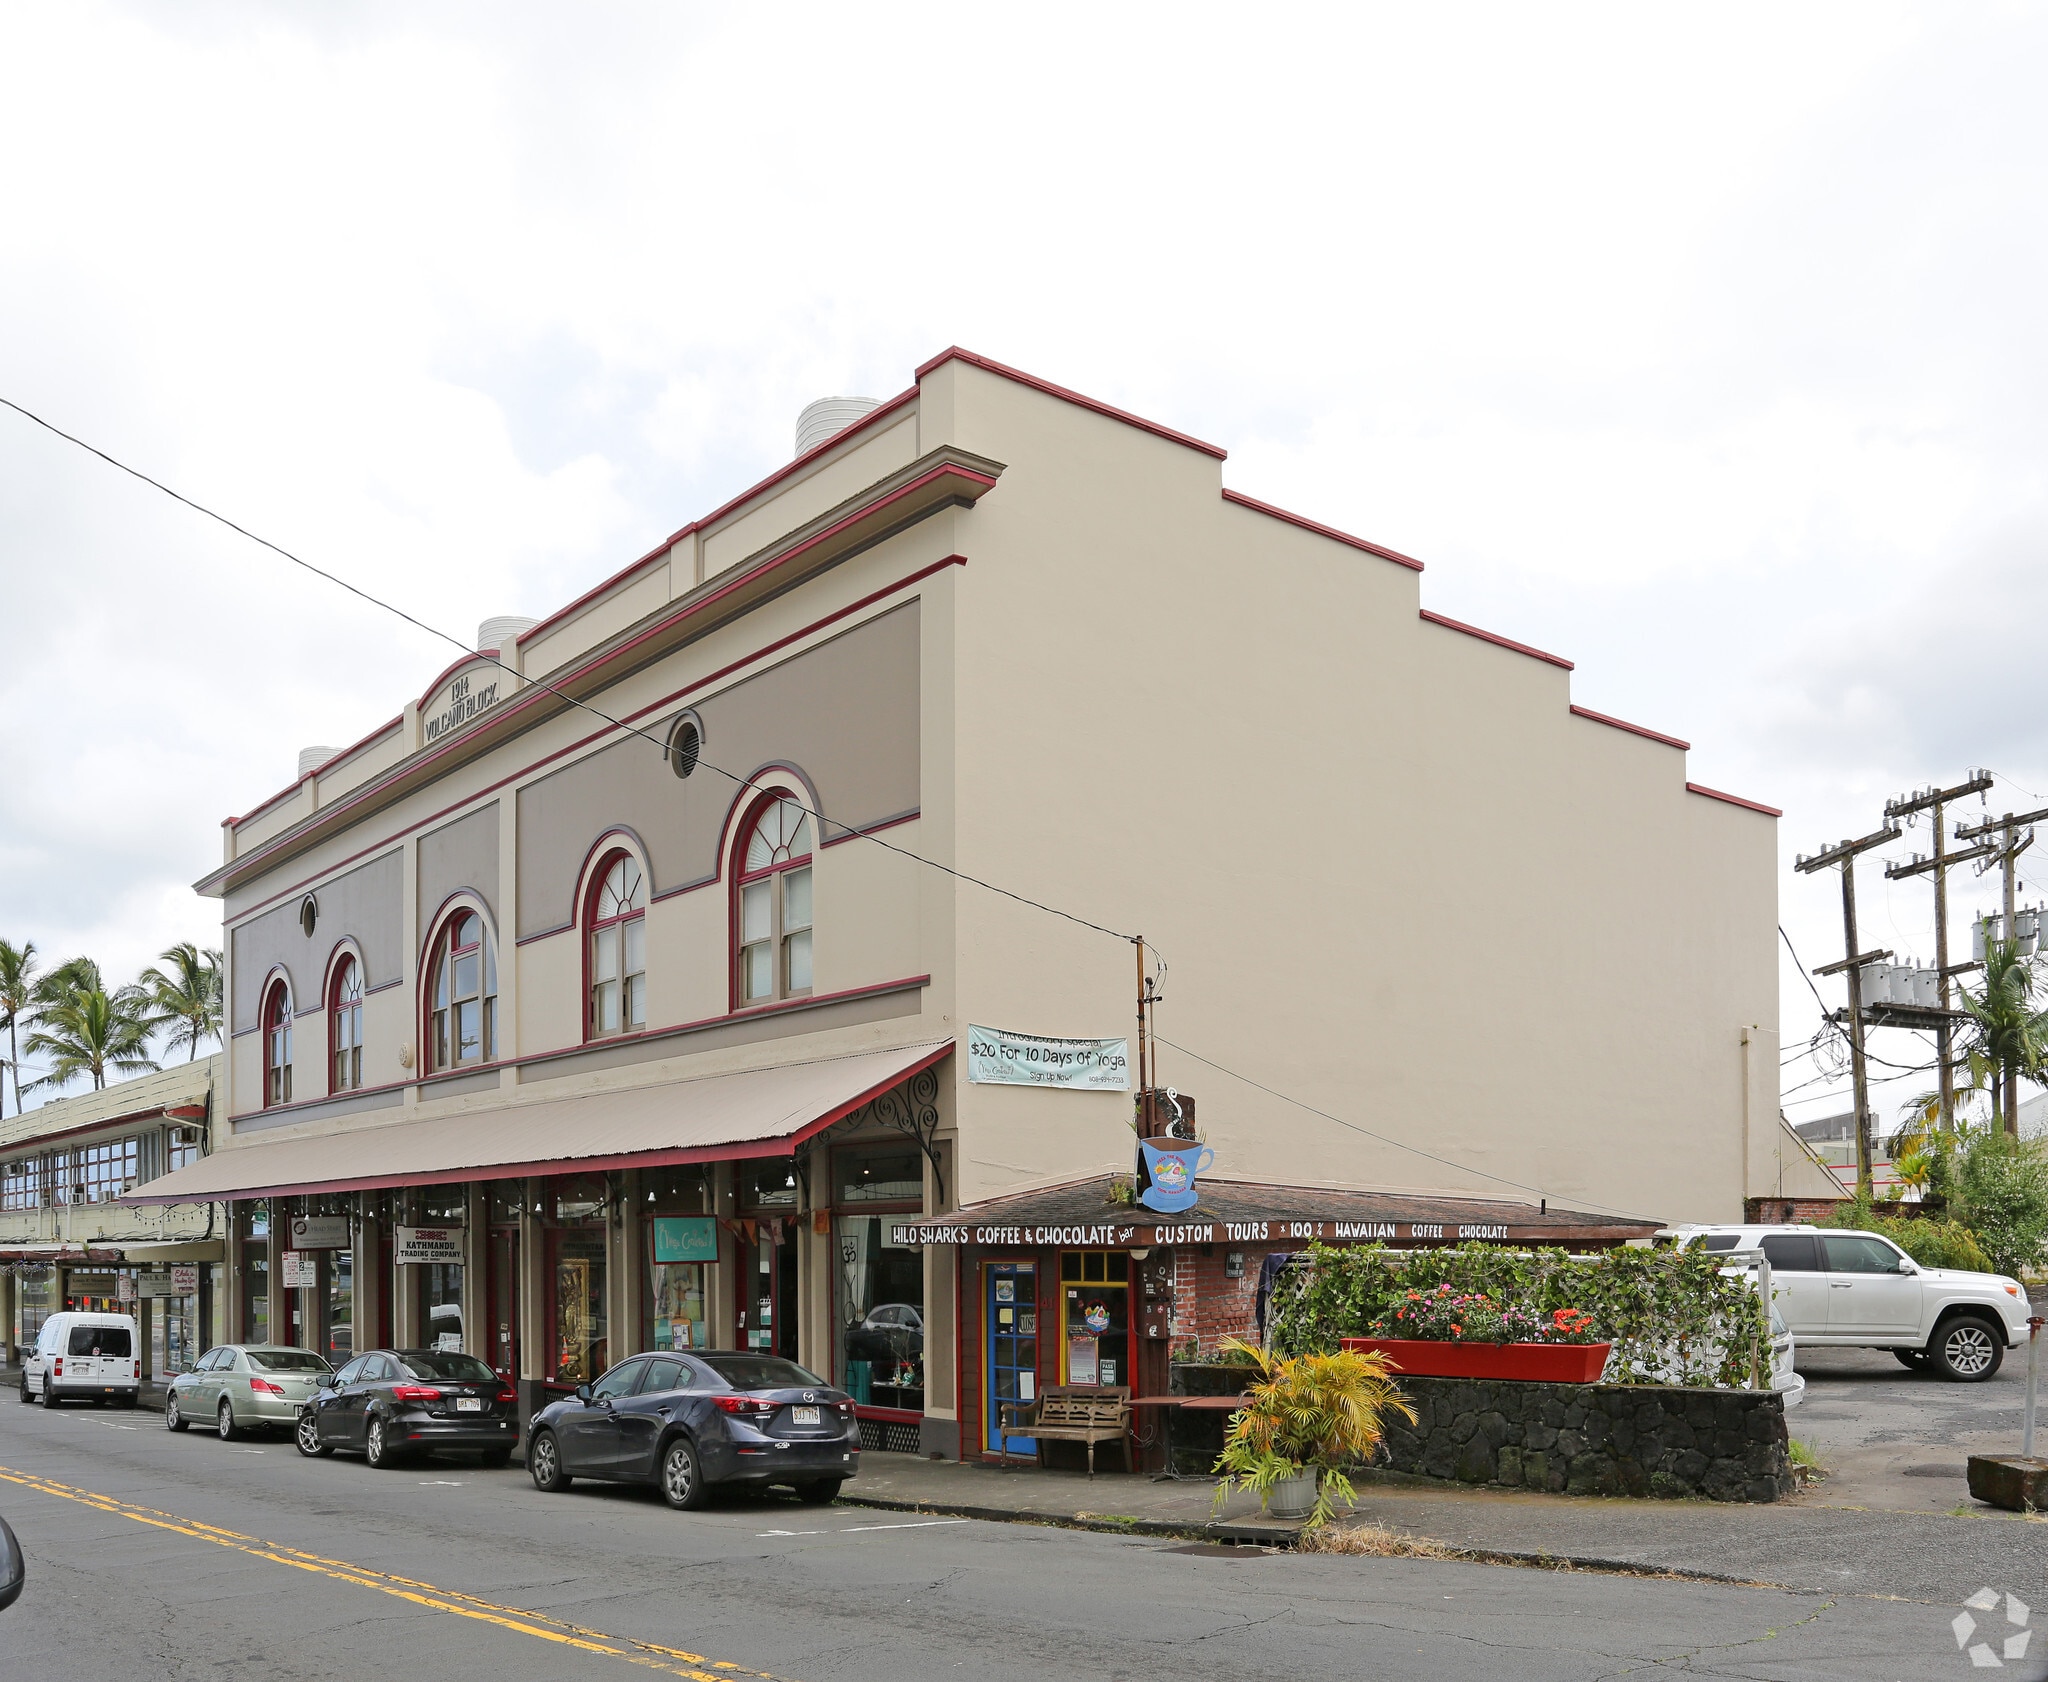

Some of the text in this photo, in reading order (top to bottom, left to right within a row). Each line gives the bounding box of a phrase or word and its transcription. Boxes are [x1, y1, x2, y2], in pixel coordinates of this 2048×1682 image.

[452, 677, 470, 702] 1914
[426, 703, 465, 741] VOLCANO
[970, 1042, 1126, 1071] $20 For 10 Days Of Yoga
[1029, 1071, 1045, 1082] Sign
[1046, 1073, 1055, 1083] Up
[892, 1225, 1135, 1245] HILO SHARK'S COFFEE & CHOCOLATE bar
[1155, 1224, 1213, 1243] CUSTOM
[1226, 1222, 1269, 1241] TOURS
[1335, 1222, 1396, 1238] HAWAIIAN
[1411, 1223, 1443, 1238] COFFEE
[1458, 1225, 1508, 1239] CHOCOLATE
[406, 1241, 455, 1250] KATHMANDU
[808, 1410, 819, 1420] 716
